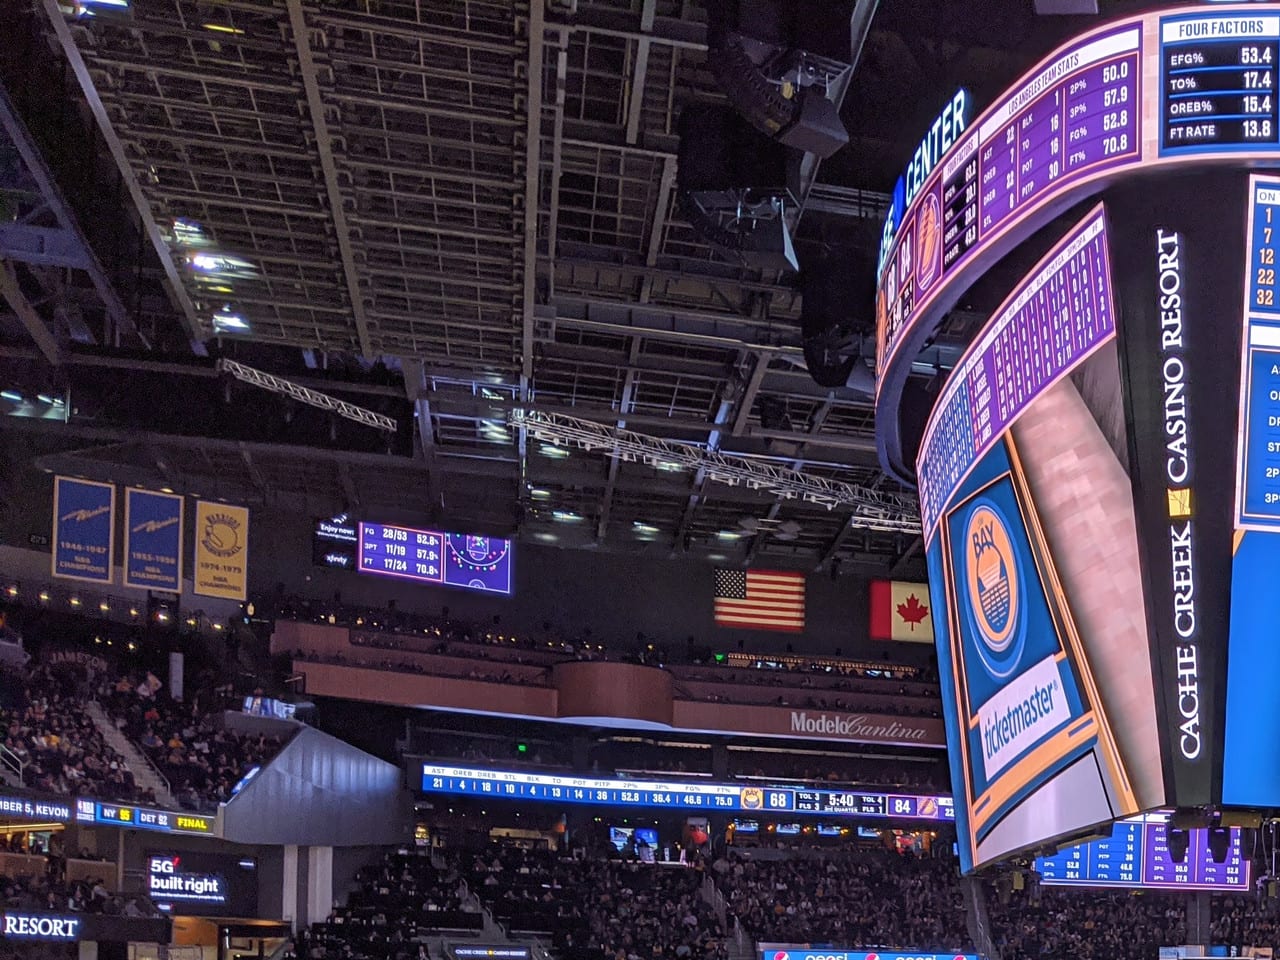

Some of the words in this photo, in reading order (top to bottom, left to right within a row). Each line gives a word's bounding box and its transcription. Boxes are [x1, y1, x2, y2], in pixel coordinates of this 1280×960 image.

[1179, 22, 1208, 37] FOUR
[1211, 20, 1264, 35] FACTORS
[1171, 53, 1204, 66] EFG%
[1241, 47, 1272, 63] 53.4
[1170, 78, 1196, 90] TO%
[1243, 71, 1272, 88] 17.4
[1170, 100, 1213, 114] OREB%
[1243, 96, 1272, 112] 15.4
[1170, 128, 1183, 139] FT
[1186, 125, 1215, 137] RATE
[1243, 121, 1271, 137] 13.8
[905, 88, 966, 207] CENTER
[1259, 191, 1276, 202] ON
[1156, 229, 1182, 350] RESORT
[1162, 356, 1187, 484] CASINO
[383, 528, 408, 541] 28/53
[973, 526, 994, 560] BAY
[386, 544, 406, 556] 11/19
[384, 559, 407, 571] 17/24
[1169, 519, 1193, 638] CREEK
[1177, 644, 1200, 760] CACHE
[791, 711, 849, 735] Modelo
[846, 714, 926, 739] Cantina
[983, 684, 1055, 761] ticketmaster
[770, 793, 787, 807] 68
[829, 794, 854, 807] 5:40
[895, 800, 911, 814] 84
[36, 805, 69, 817] KEVON
[103, 809, 116, 818] NY
[141, 813, 156, 823] DET
[177, 817, 207, 829] FINAL
[151, 859, 174, 874] 5G
[151, 875, 183, 890] built
[185, 878, 218, 894] right
[4, 916, 78, 937] RESORT
